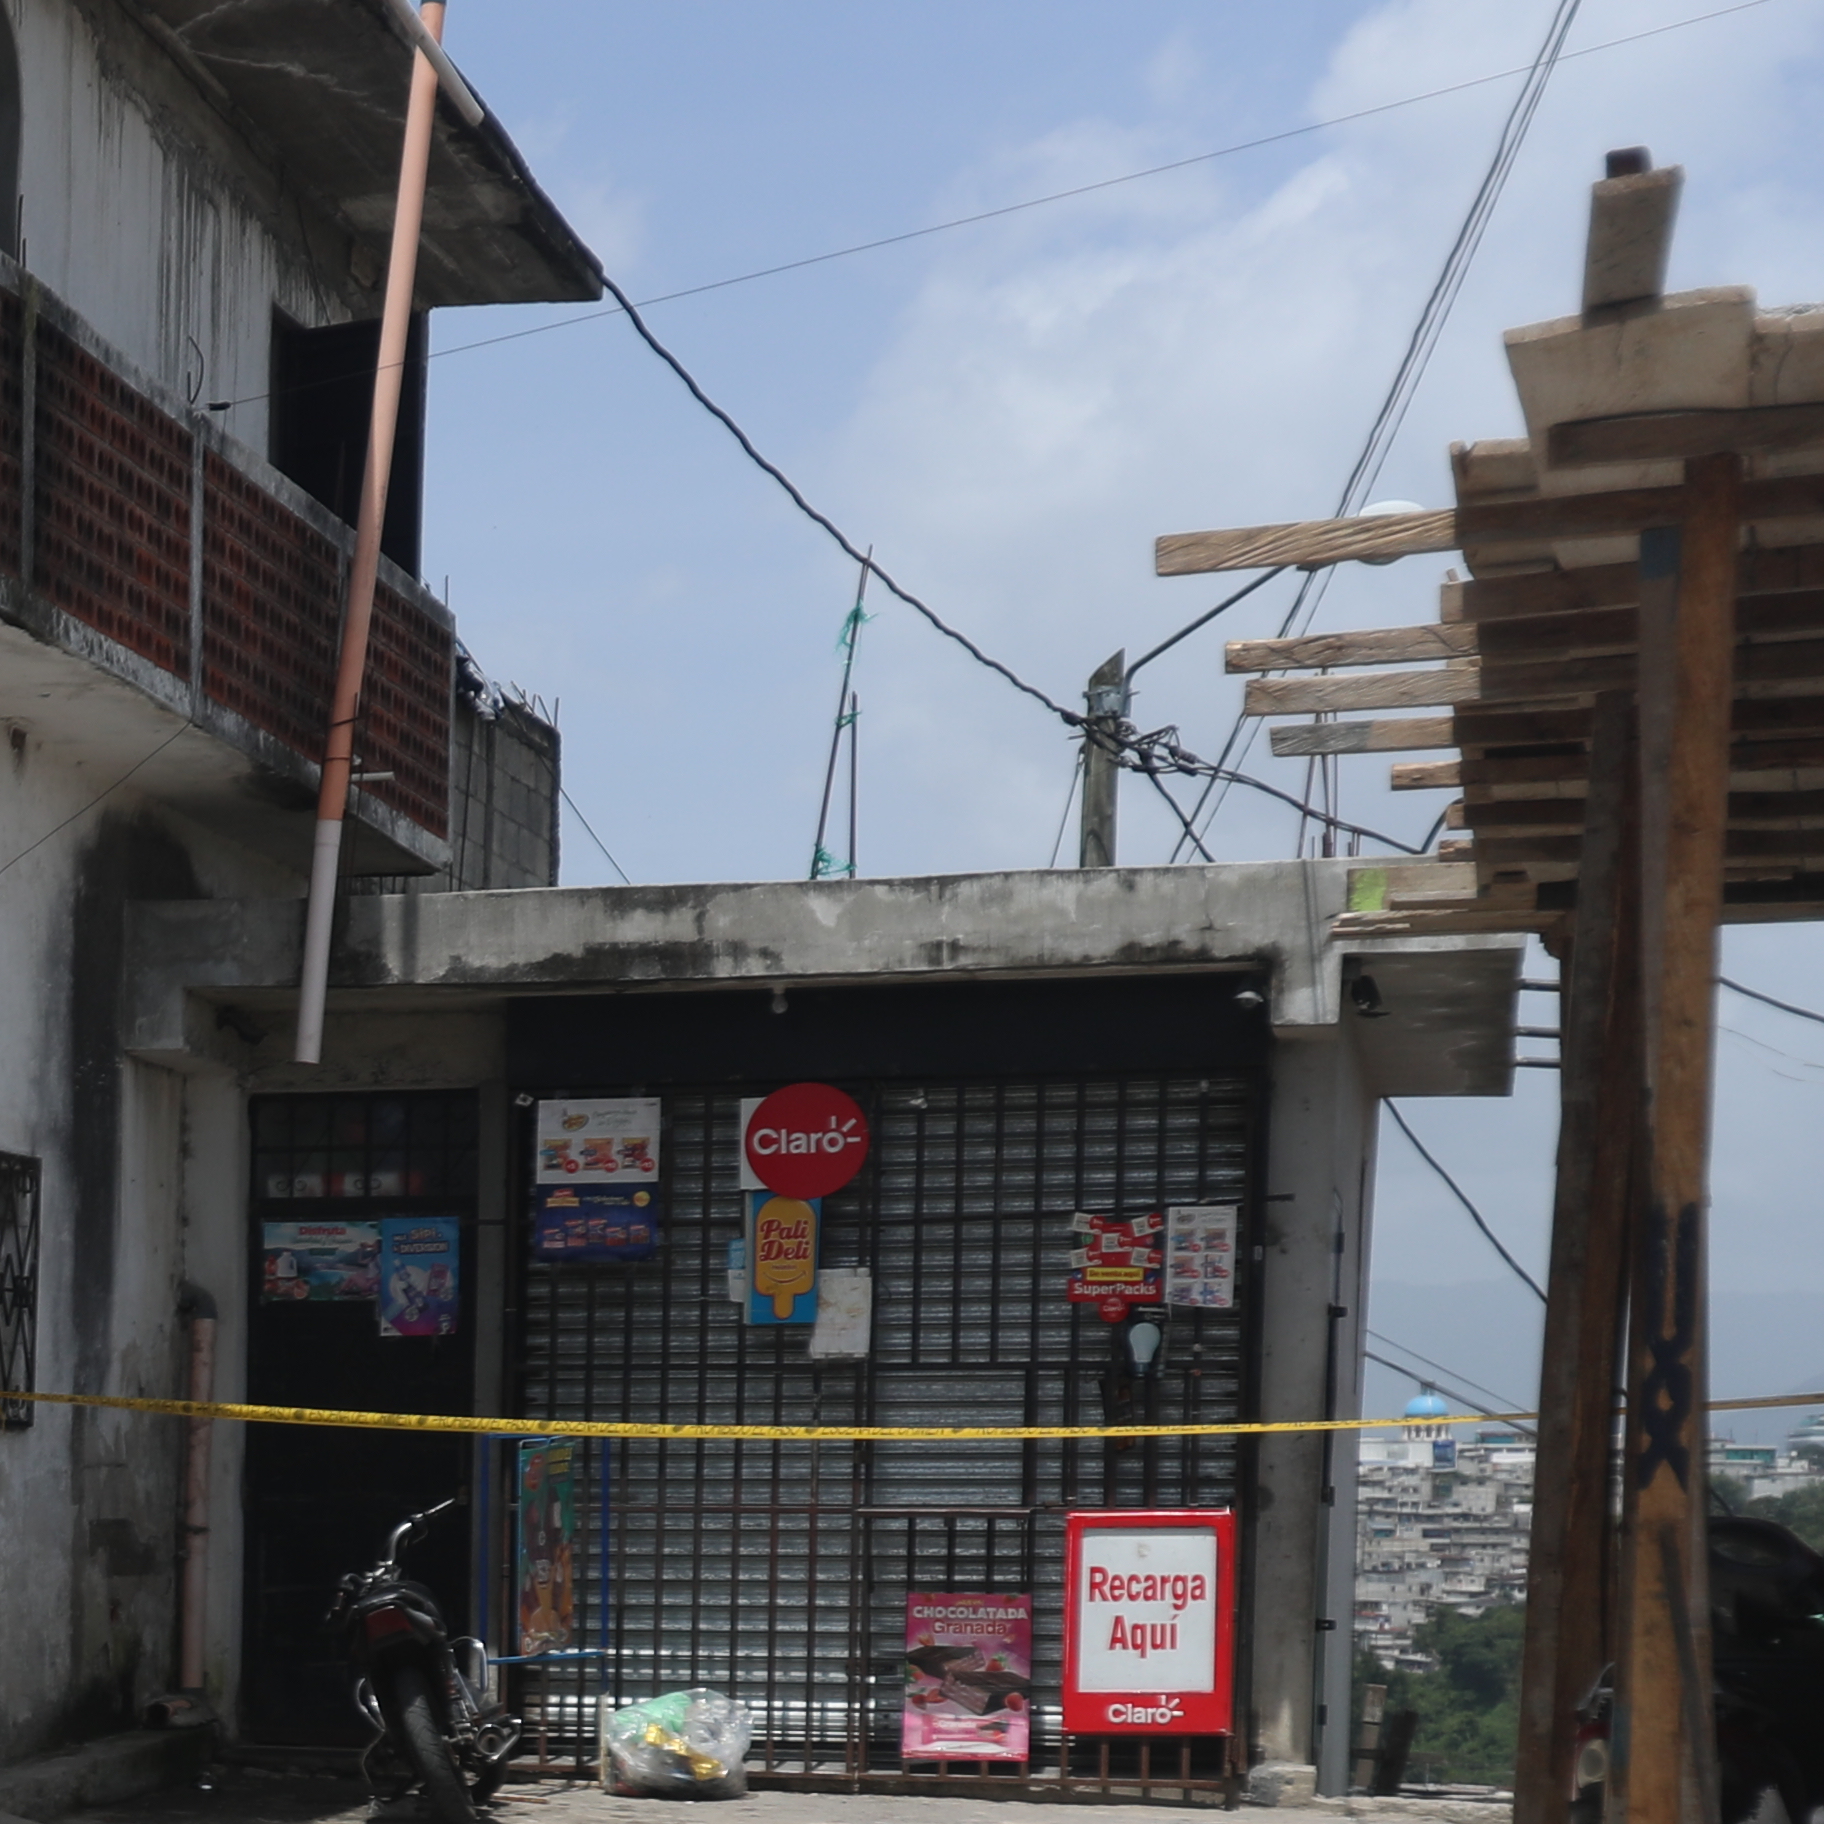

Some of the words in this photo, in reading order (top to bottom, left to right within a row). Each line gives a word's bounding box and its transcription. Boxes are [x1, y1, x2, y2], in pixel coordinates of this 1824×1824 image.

[752, 1126, 846, 1155] Claro
[759, 1218, 809, 1242] Pali
[759, 1240, 811, 1262] Deli
[1072, 1282, 1157, 1297] SuperPacks
[1088, 1565, 1208, 1611] Recarga
[912, 1605, 1029, 1620] CHOCOLATADA
[932, 1620, 1007, 1636] Granada
[1108, 1613, 1179, 1659] Aquí
[1106, 1701, 1173, 1727] Claro
